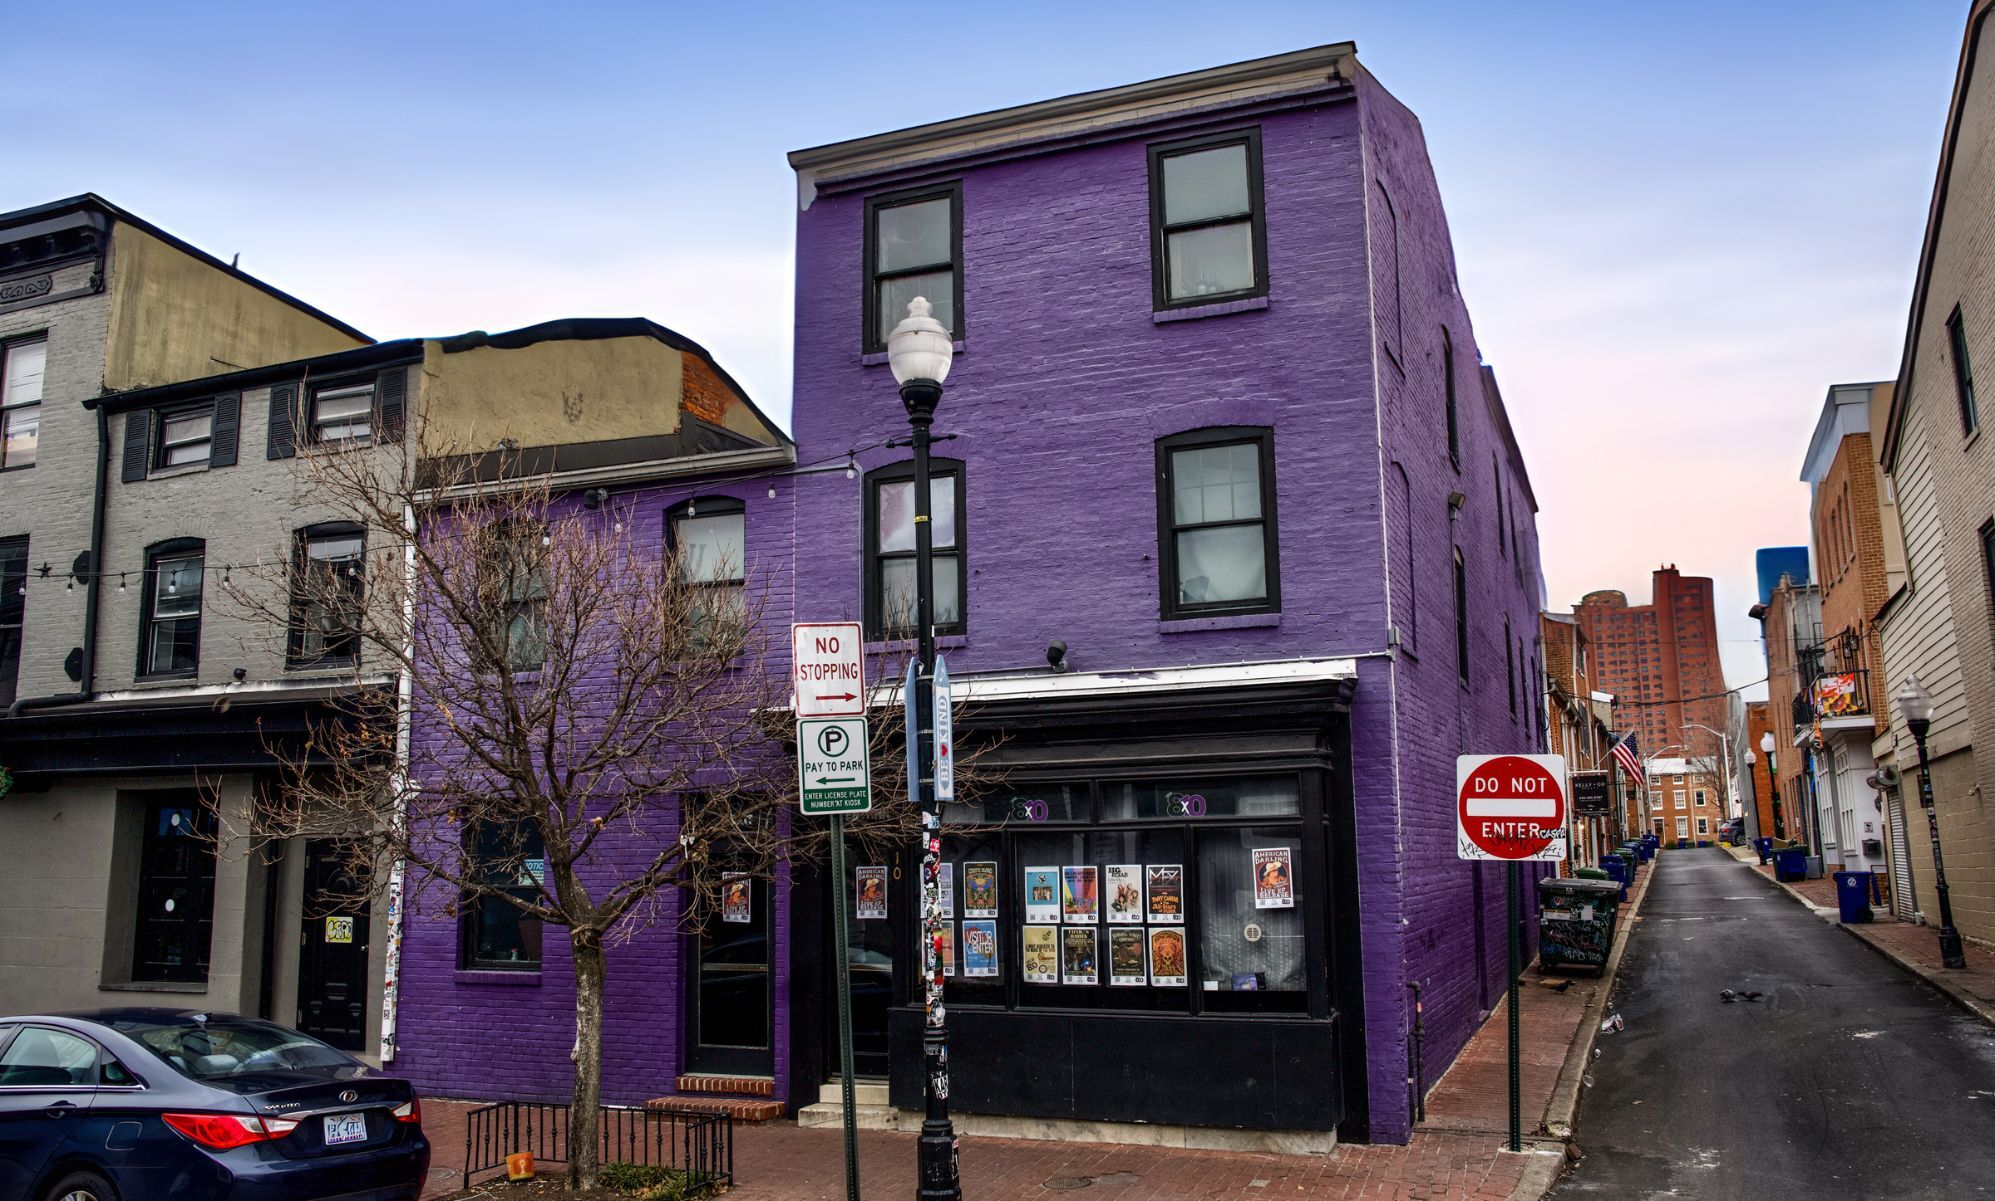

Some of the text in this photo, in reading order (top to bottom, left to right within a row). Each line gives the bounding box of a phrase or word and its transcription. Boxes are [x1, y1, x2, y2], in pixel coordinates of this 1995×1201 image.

[816, 638, 840, 654] NO
[800, 663, 858, 680] STOPPING
[825, 731, 842, 752] P
[940, 696, 949, 782] BE KIND
[806, 760, 864, 772] PAY TO PARK
[1475, 778, 1548, 793] DO NOT
[1482, 822, 1540, 838] ENTER
[1254, 850, 1288, 859] AMERICAN
[966, 931, 992, 943] VISITOR
[967, 943, 993, 955] CENTER
